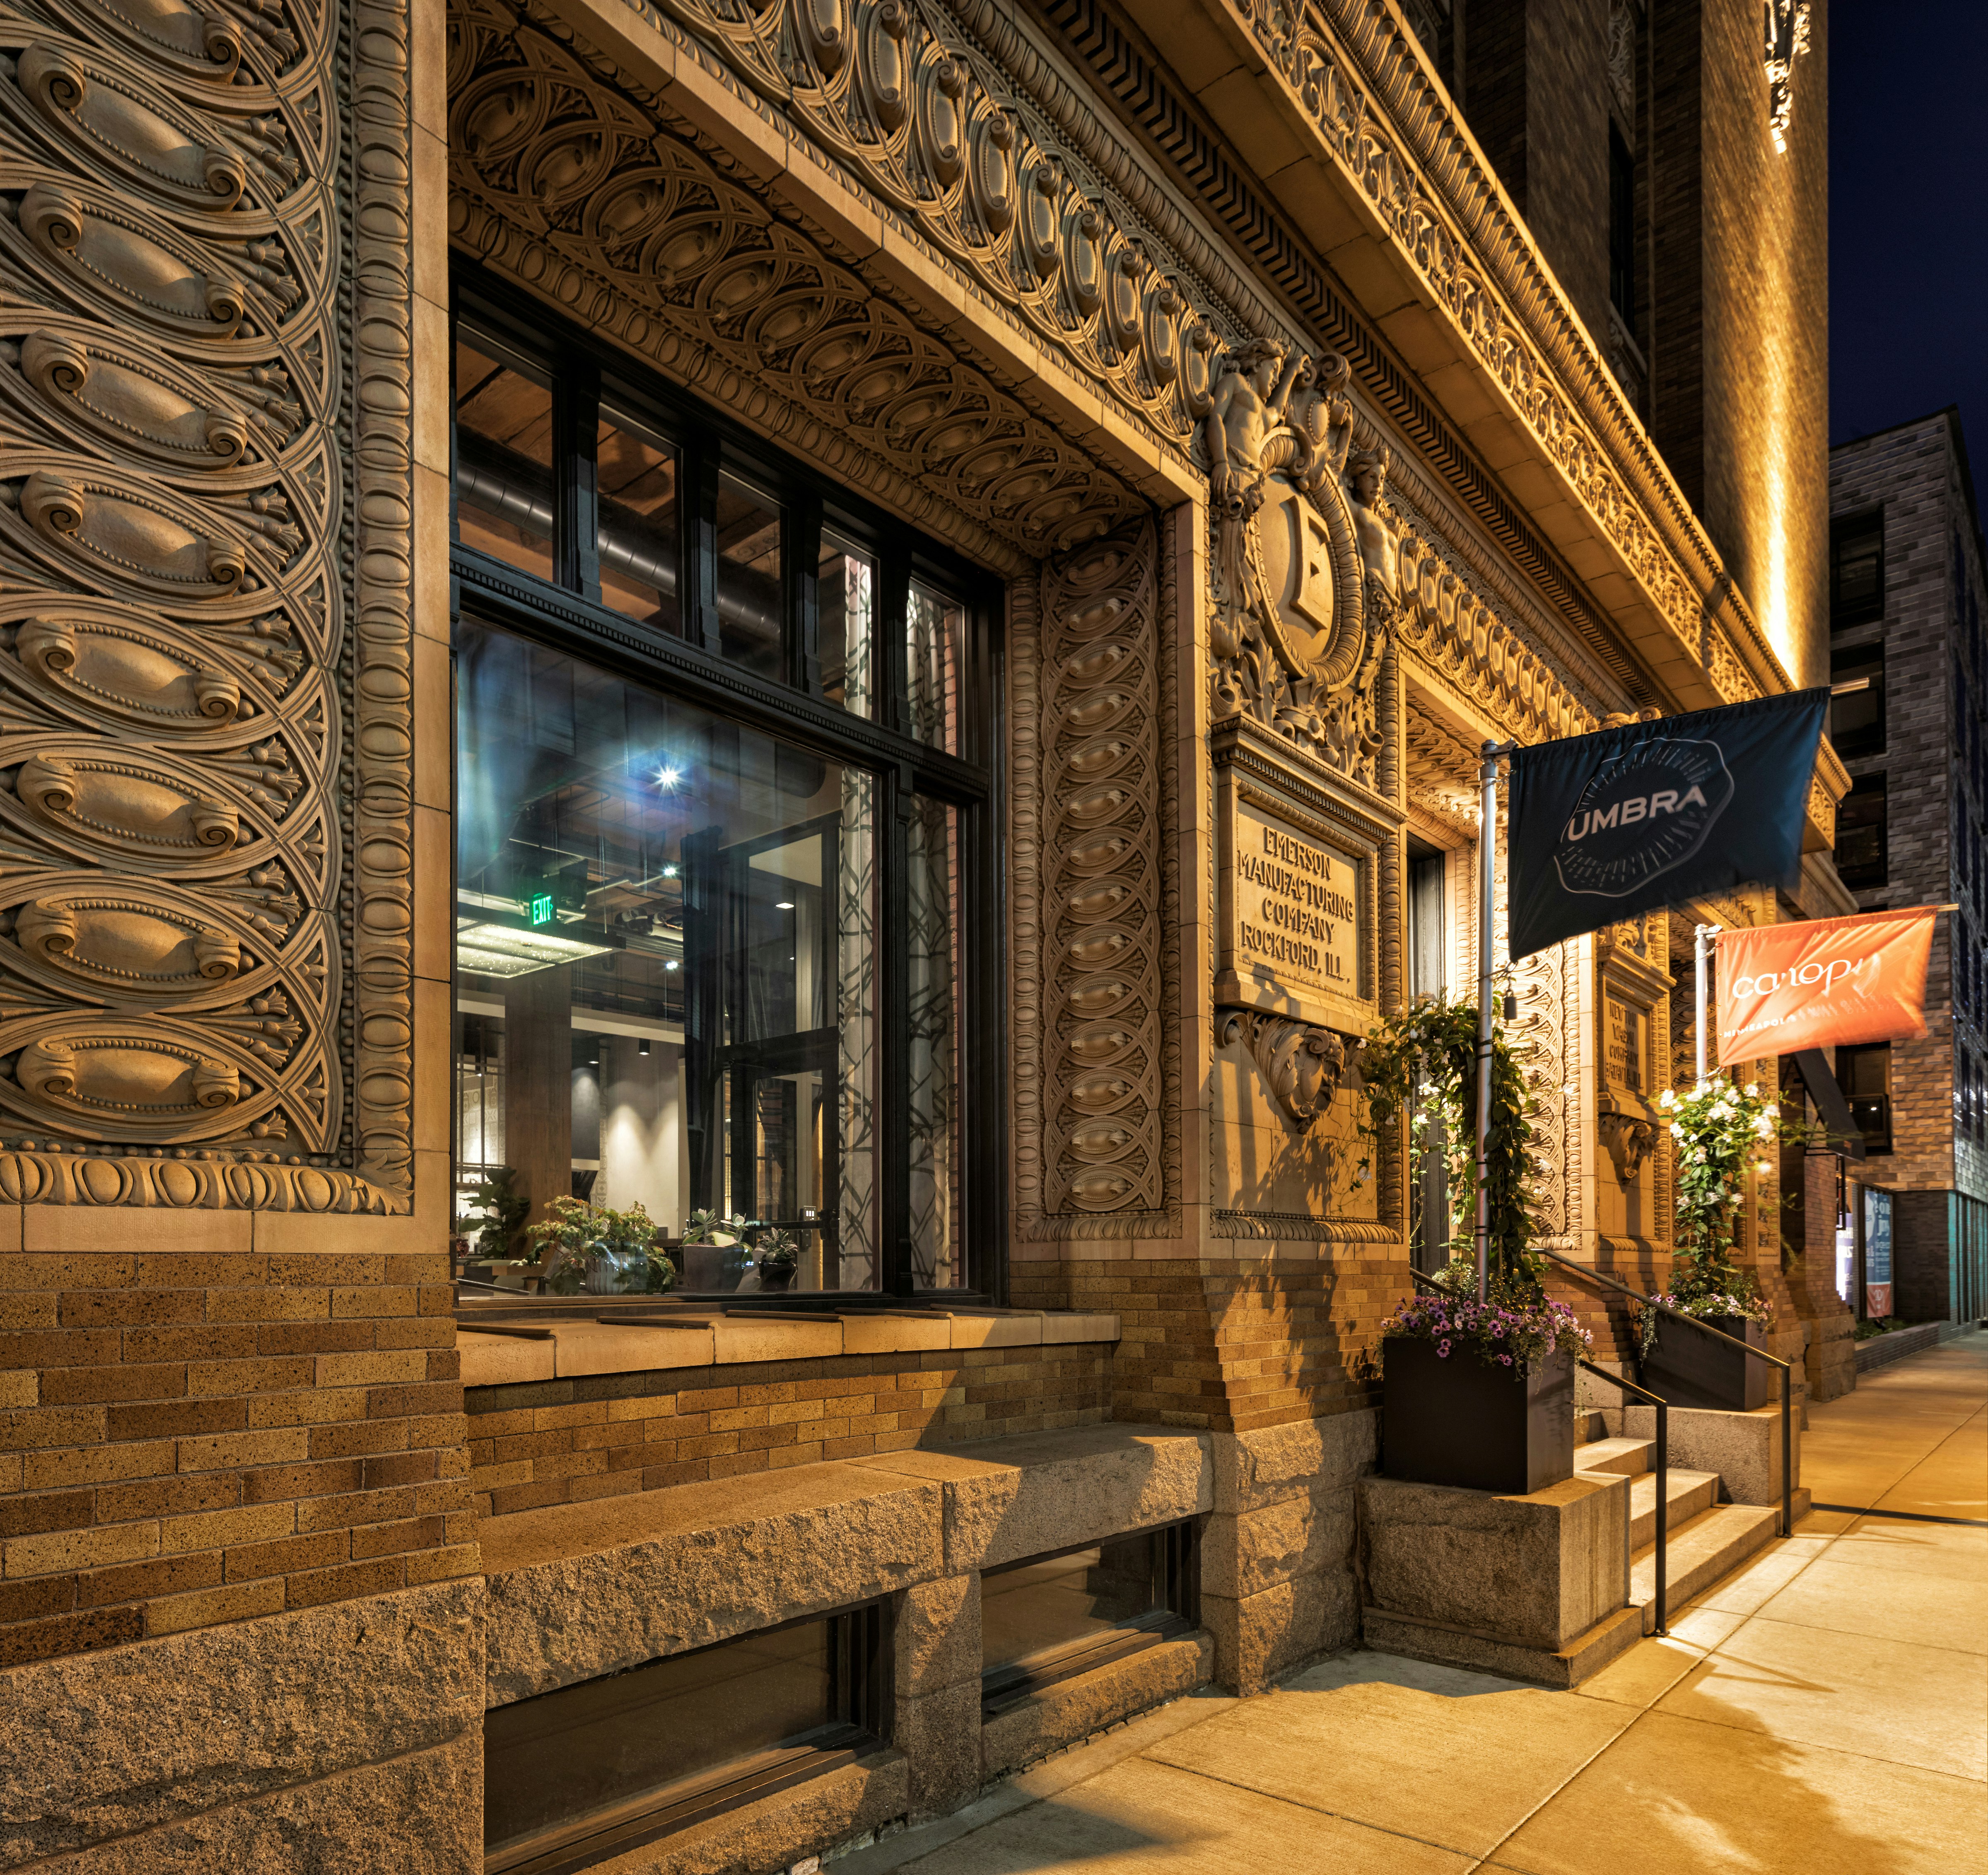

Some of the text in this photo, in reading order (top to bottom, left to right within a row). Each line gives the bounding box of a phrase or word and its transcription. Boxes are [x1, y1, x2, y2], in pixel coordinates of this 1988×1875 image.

[1568, 785, 1707, 841] UMBRA
[1264, 827, 1332, 880] EMERSON
[533, 895, 551, 925] EXIT
[1238, 850, 1354, 922] MANUFACTURING
[1262, 897, 1335, 945] COMPANY
[1325, 952, 1351, 984] ILL.
[1609, 1044, 1638, 1066] COMPANY
